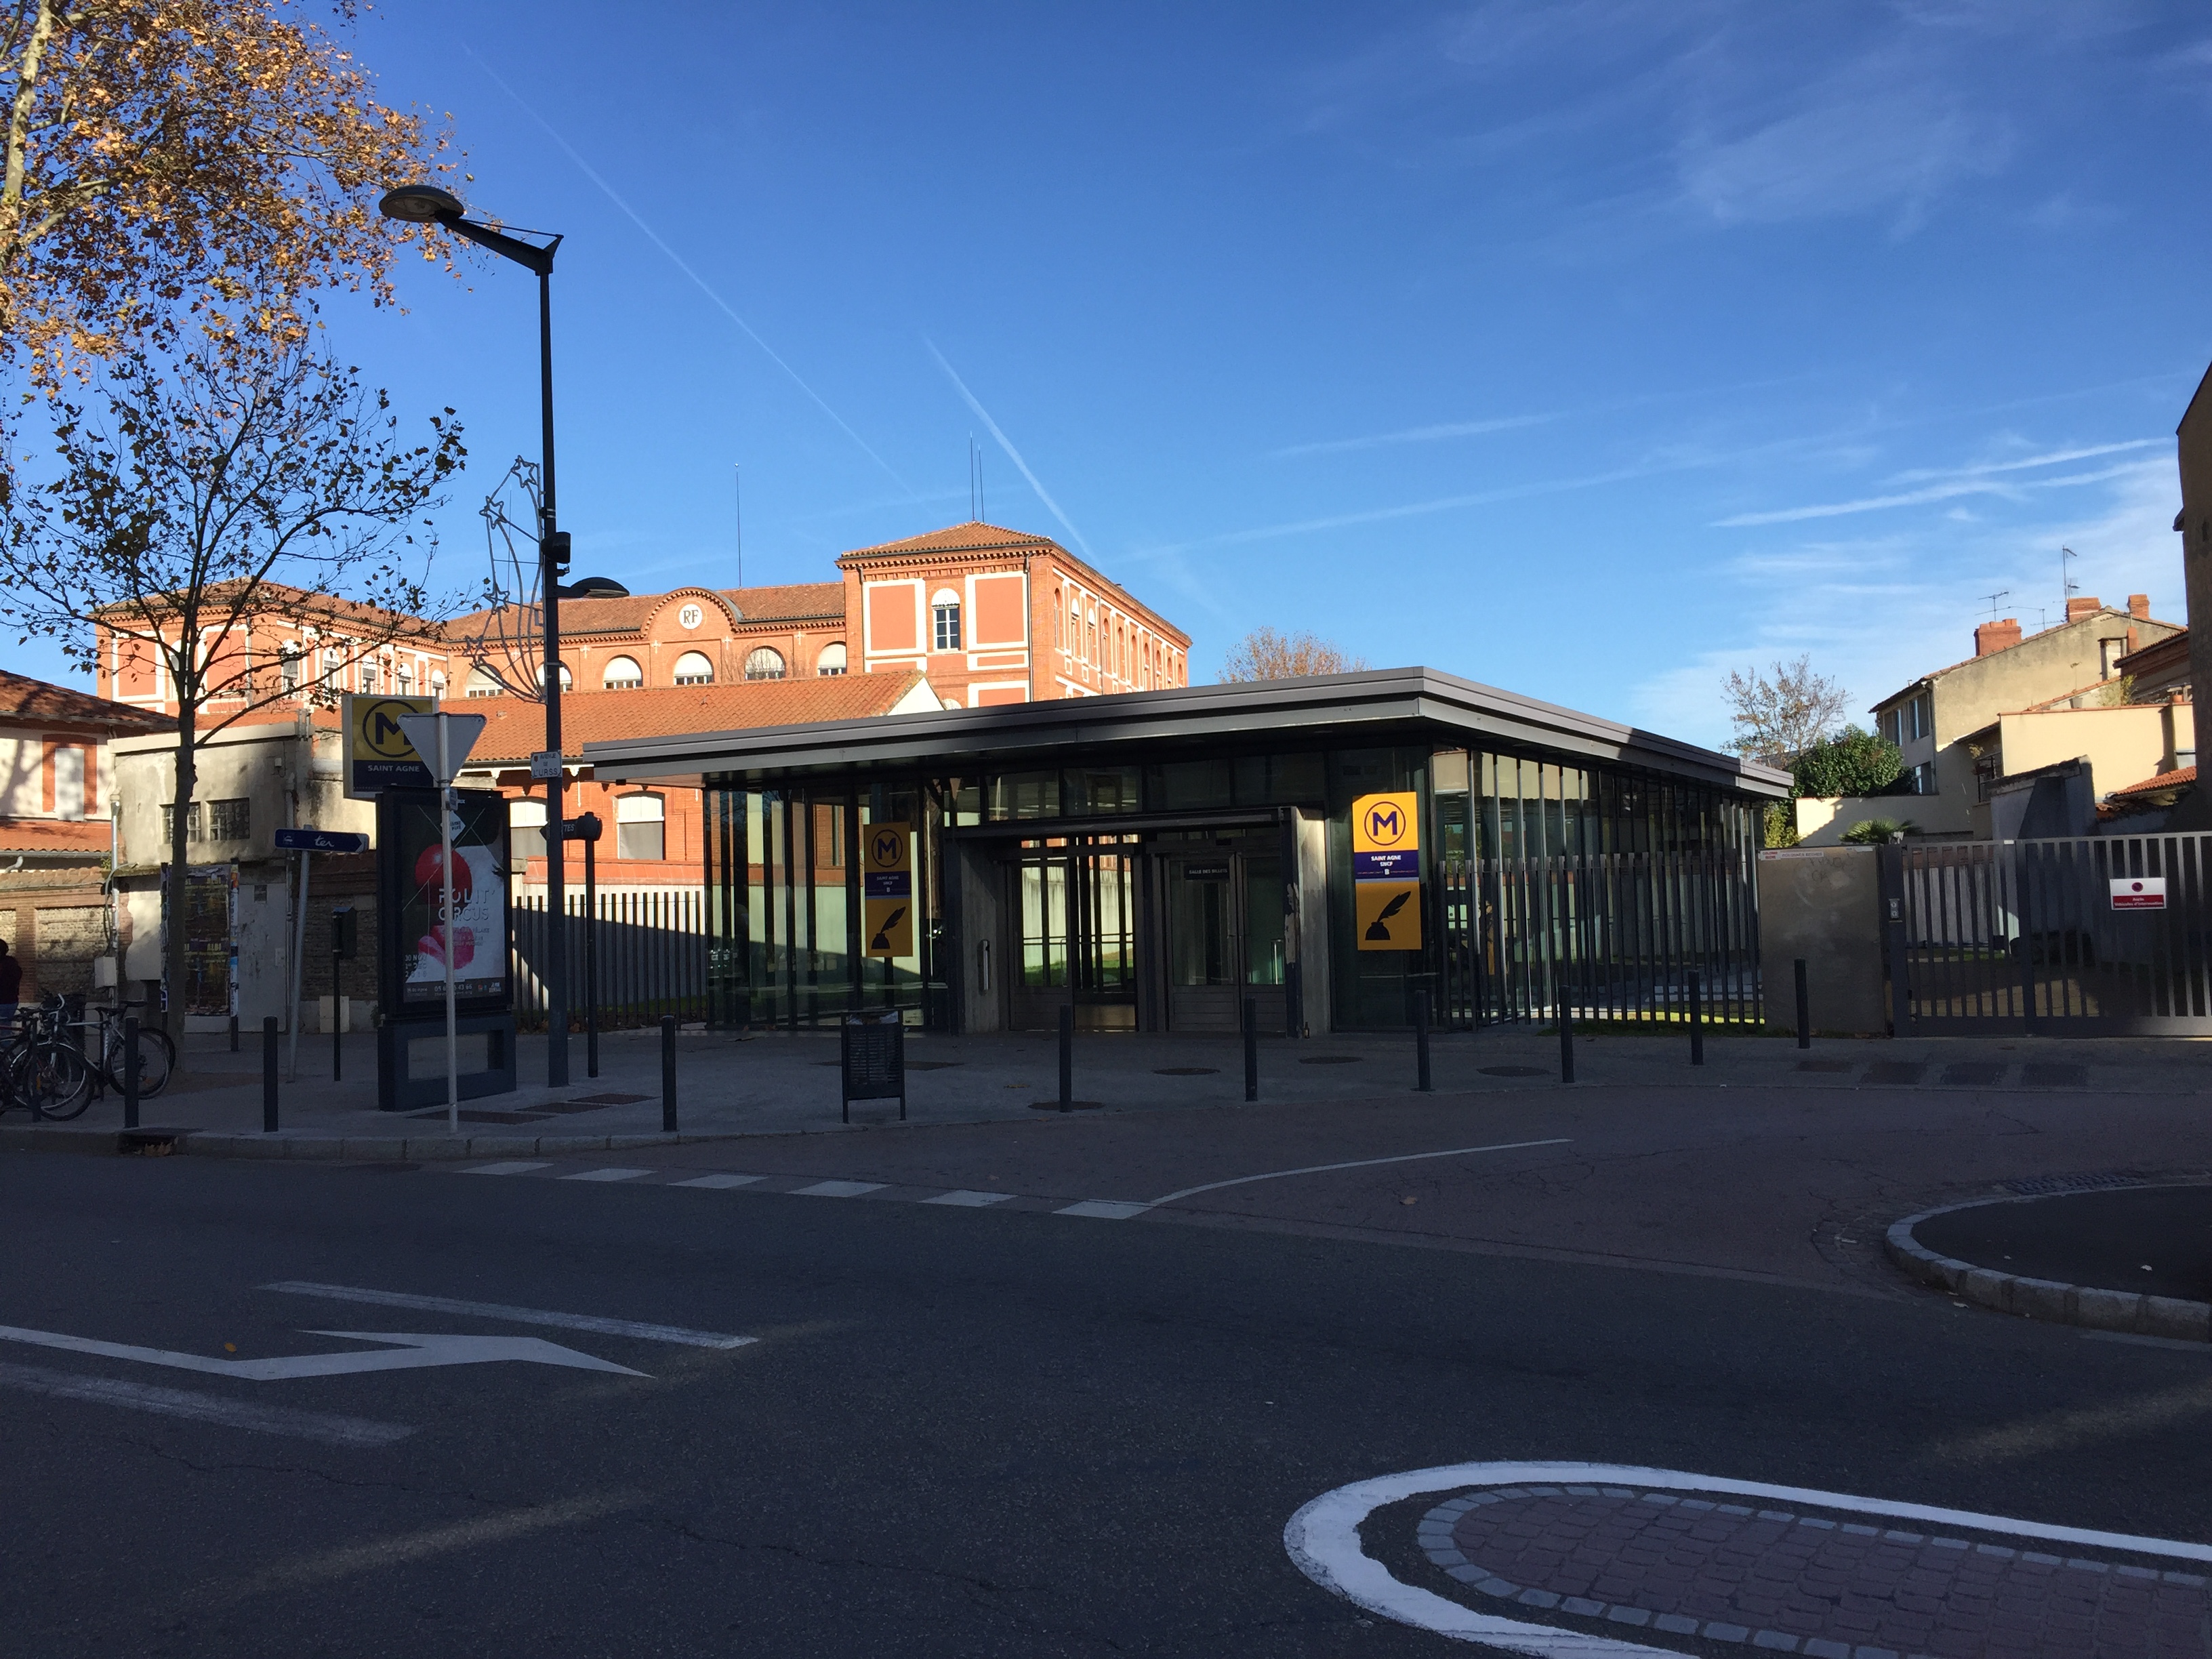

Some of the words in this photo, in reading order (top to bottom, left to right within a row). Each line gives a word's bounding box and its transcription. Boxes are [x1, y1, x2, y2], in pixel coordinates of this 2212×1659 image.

[683, 609, 699, 625] RF
[533, 767, 558, 777] L'URSS
[1372, 811, 1397, 836] M
[314, 835, 335, 847] ter
[878, 838, 897, 859] M
[438, 907, 489, 921] CRCUS
